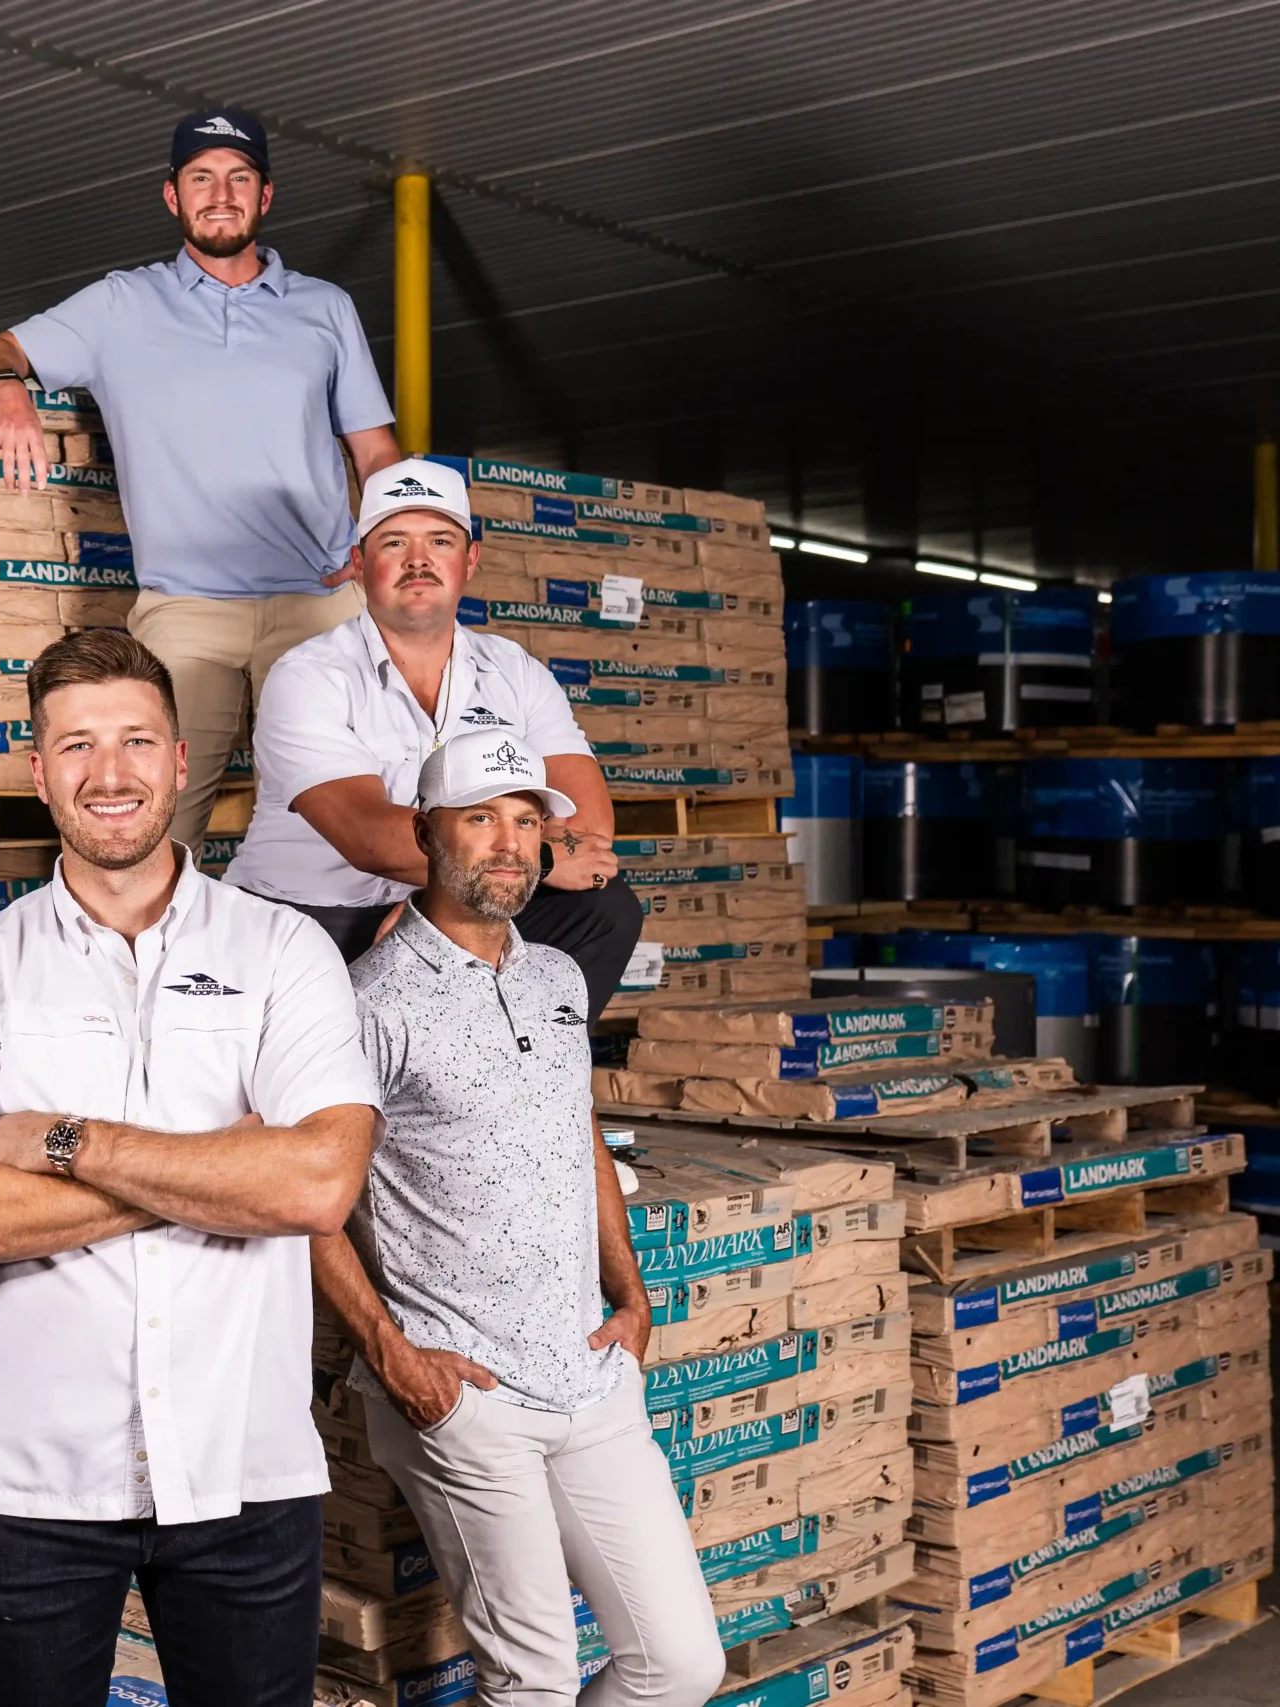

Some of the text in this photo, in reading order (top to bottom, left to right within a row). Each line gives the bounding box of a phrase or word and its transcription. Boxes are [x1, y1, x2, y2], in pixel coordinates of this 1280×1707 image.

[478, 464, 567, 491] LANDMARK
[583, 504, 665, 525] LANDMARK
[6, 560, 134, 586] LANDMARK
[496, 603, 582, 624] LANDMARK
[836, 1013, 906, 1034] LANDMARK
[1070, 1159, 1147, 1189] LANDMARK
[776, 1222, 791, 1234] AR
[645, 1227, 764, 1273] LANDMARK
[1006, 1266, 1088, 1299] LANDMARK
[1103, 1281, 1179, 1314] LANDMARK
[651, 1343, 769, 1390] LANDMARK
[1006, 1336, 1088, 1373] LANDMARK
[668, 1421, 771, 1461] ANDMARK
[1016, 1431, 1099, 1473] LANDMARK
[1017, 1527, 1099, 1574] LANDMARK
